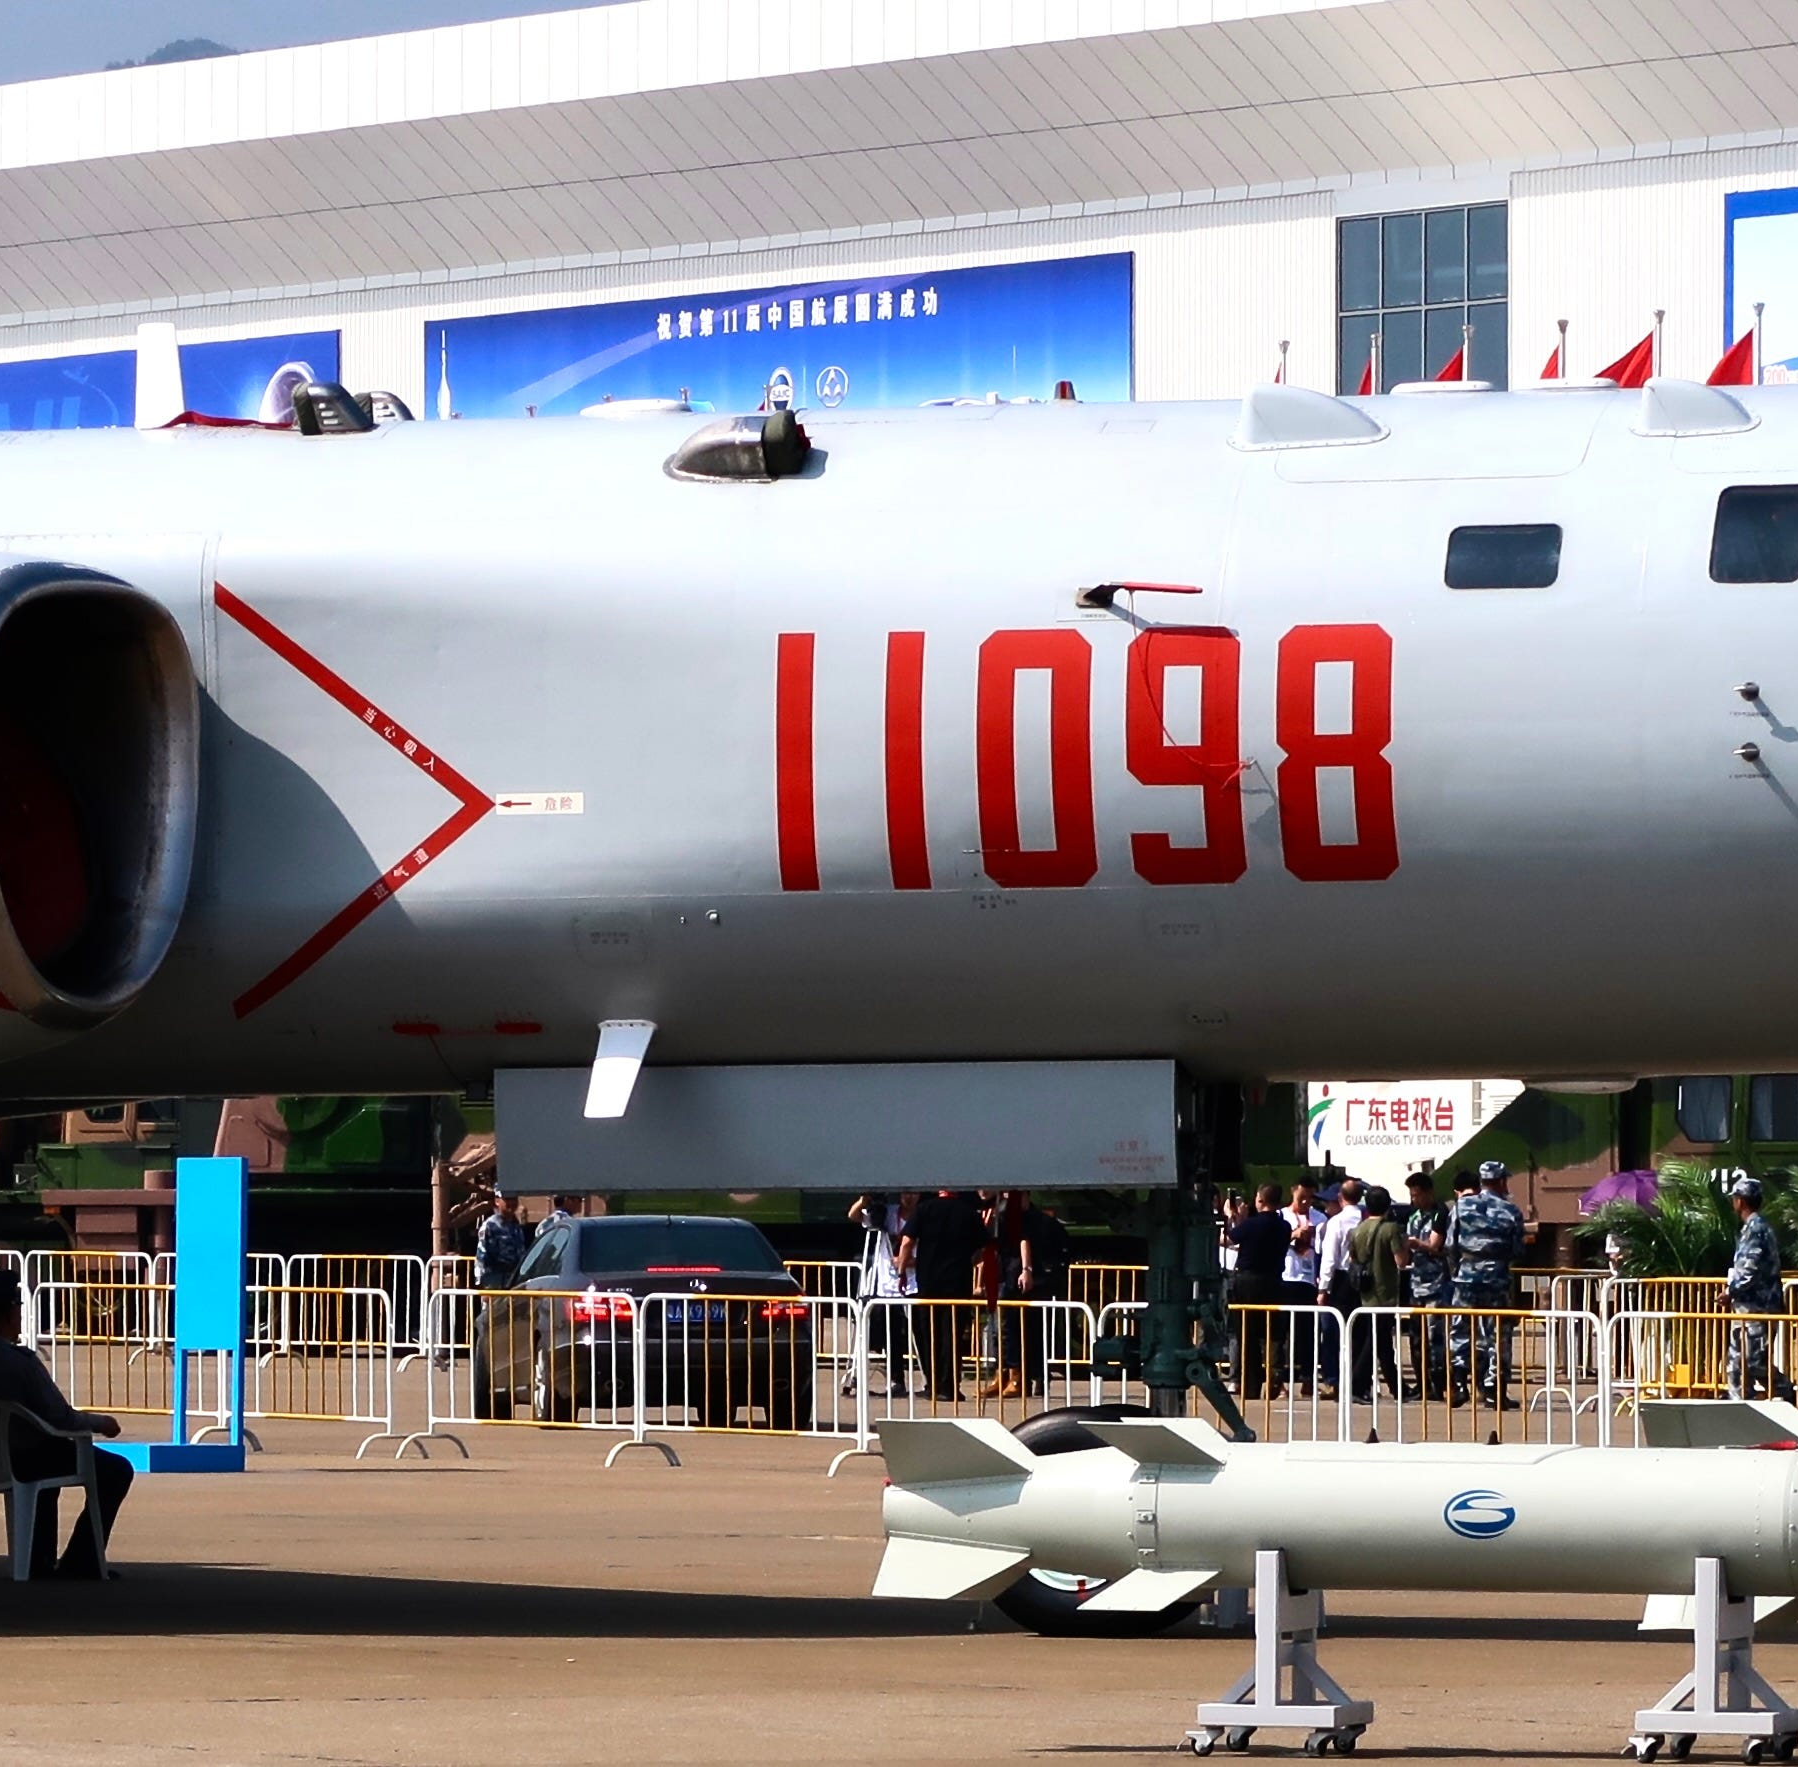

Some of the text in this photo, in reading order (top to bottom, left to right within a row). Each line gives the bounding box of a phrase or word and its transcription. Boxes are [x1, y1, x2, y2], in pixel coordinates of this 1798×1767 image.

[362, 707, 436, 773] 当心吸入
[775, 624, 1400, 892] 11098
[544, 796, 573, 811] 危险
[371, 847, 430, 890] 进气道
[1346, 1097, 1453, 1131] 广东电视台
[1402, 1133, 1413, 1146] TV
[1416, 1133, 1453, 1146] STATION
